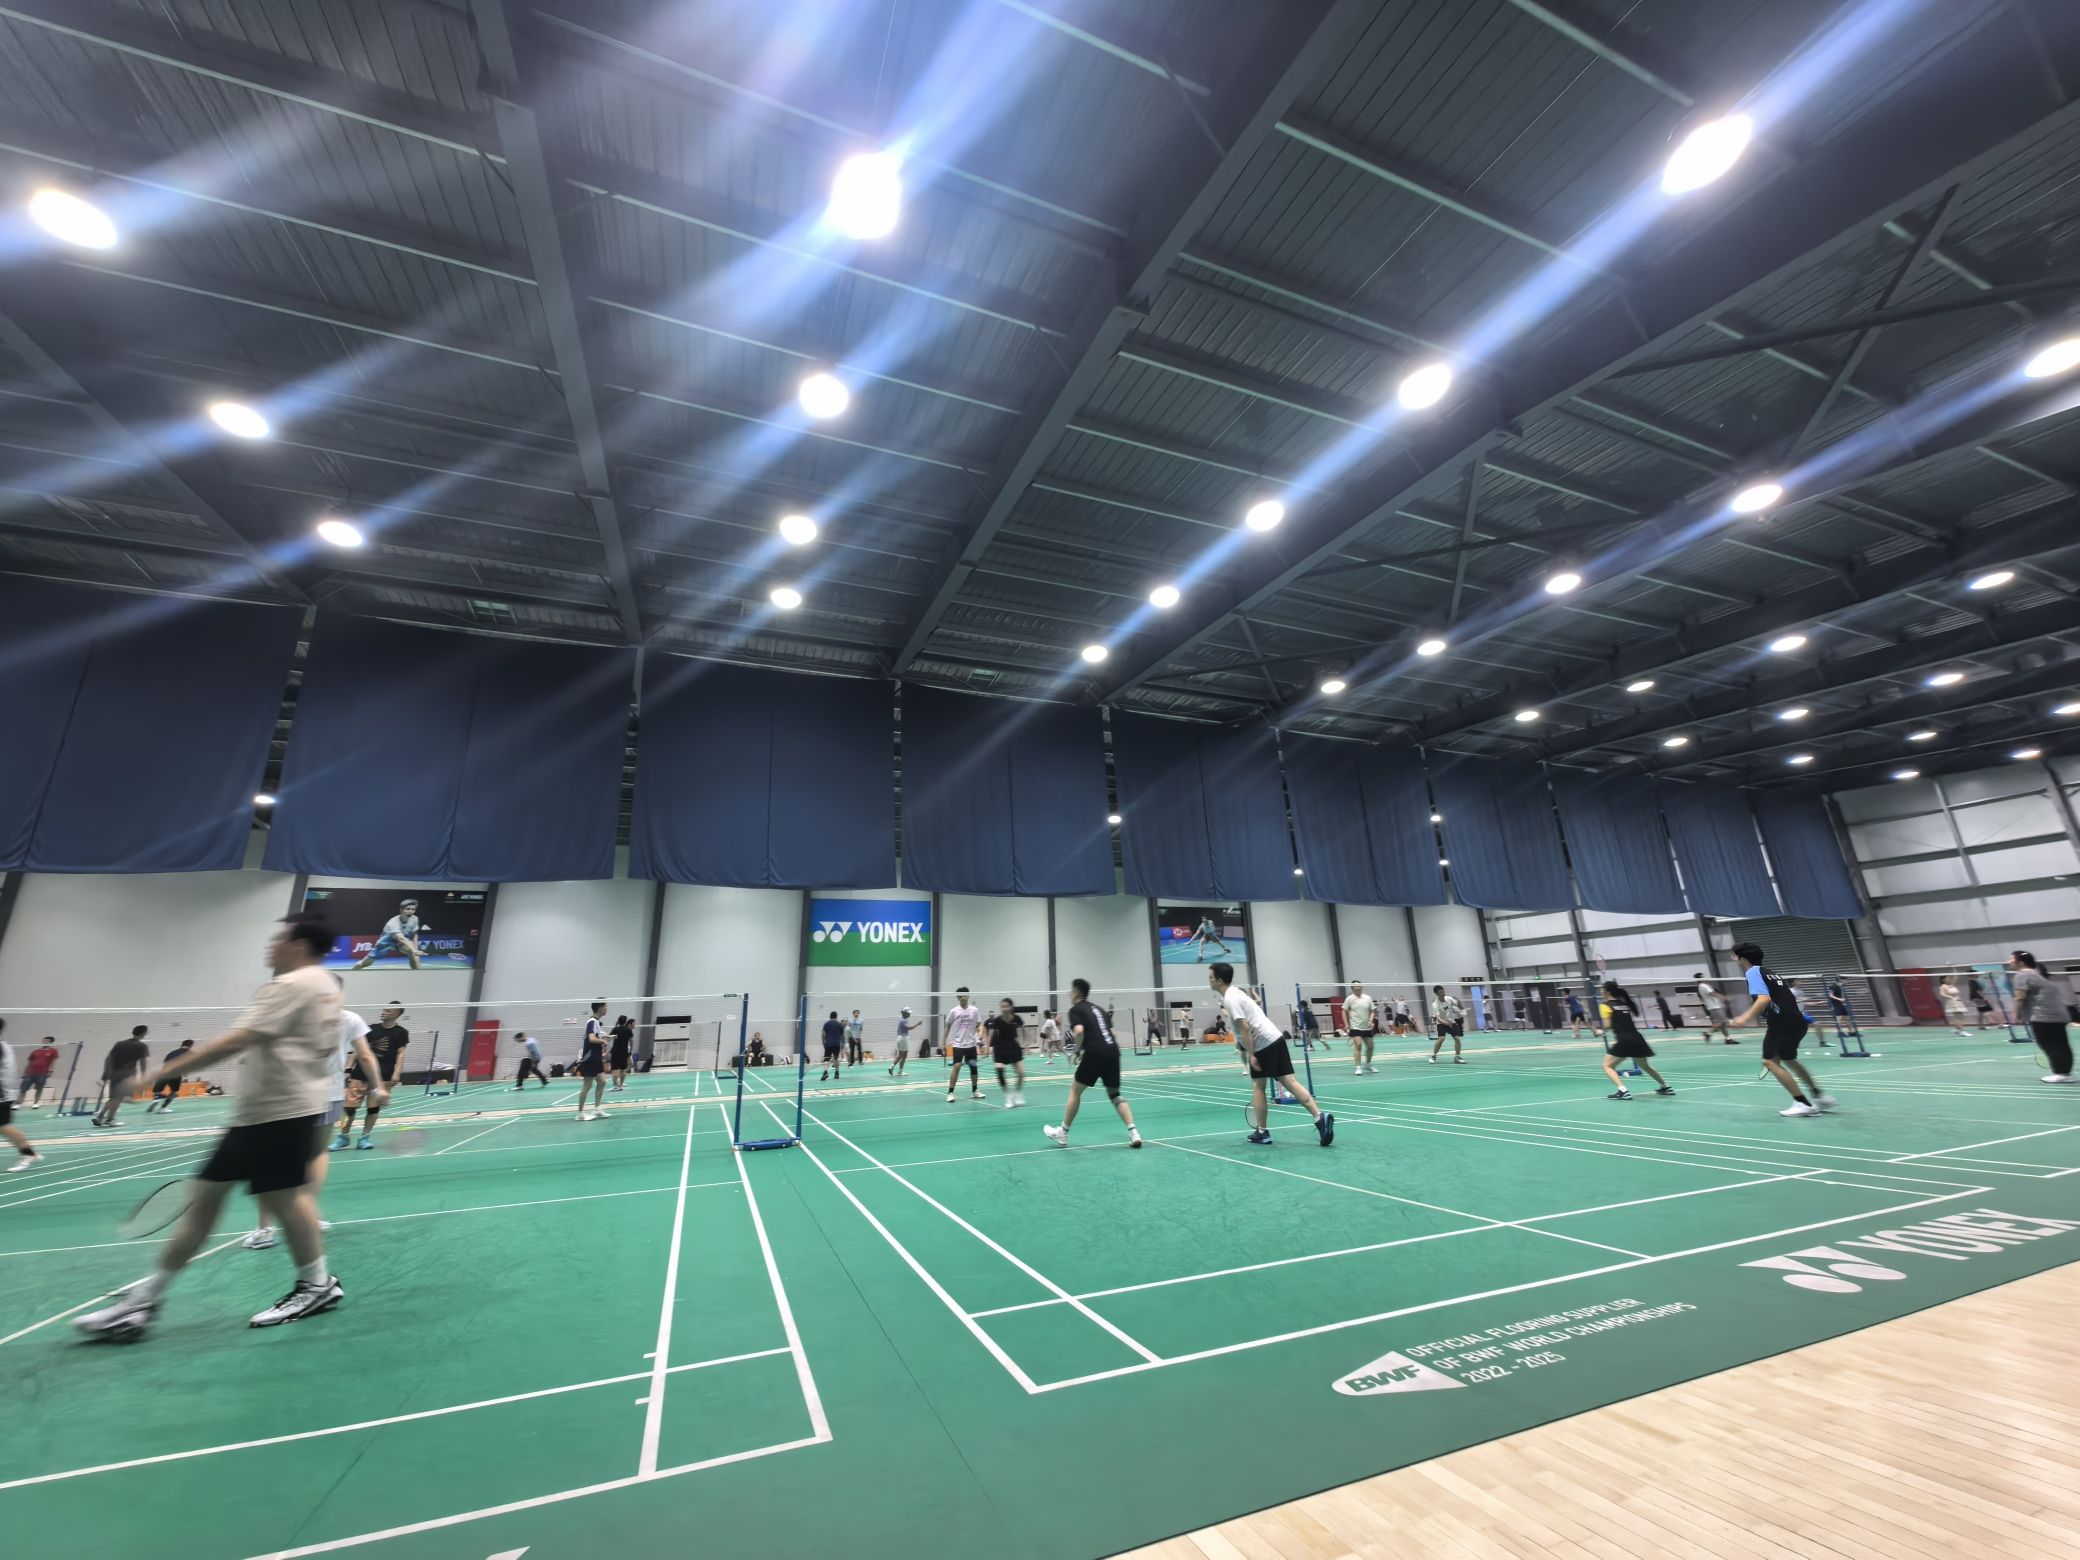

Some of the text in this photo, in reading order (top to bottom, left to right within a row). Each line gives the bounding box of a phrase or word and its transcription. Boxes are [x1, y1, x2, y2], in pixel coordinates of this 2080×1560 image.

[432, 939, 465, 950] YONEX
[857, 921, 924, 943] YONEX
[1834, 1208, 2080, 1261] YONEX
[1405, 1298, 1646, 1357] OFFICIAL FLOORING SUPPLIER
[1432, 1302, 1697, 1370] OF BWF WORLD CHAMPIONSHIPS
[1345, 1364, 1420, 1392] BWF
[1460, 1365, 1512, 1383] 2022
[1515, 1351, 1567, 1369] 2025
